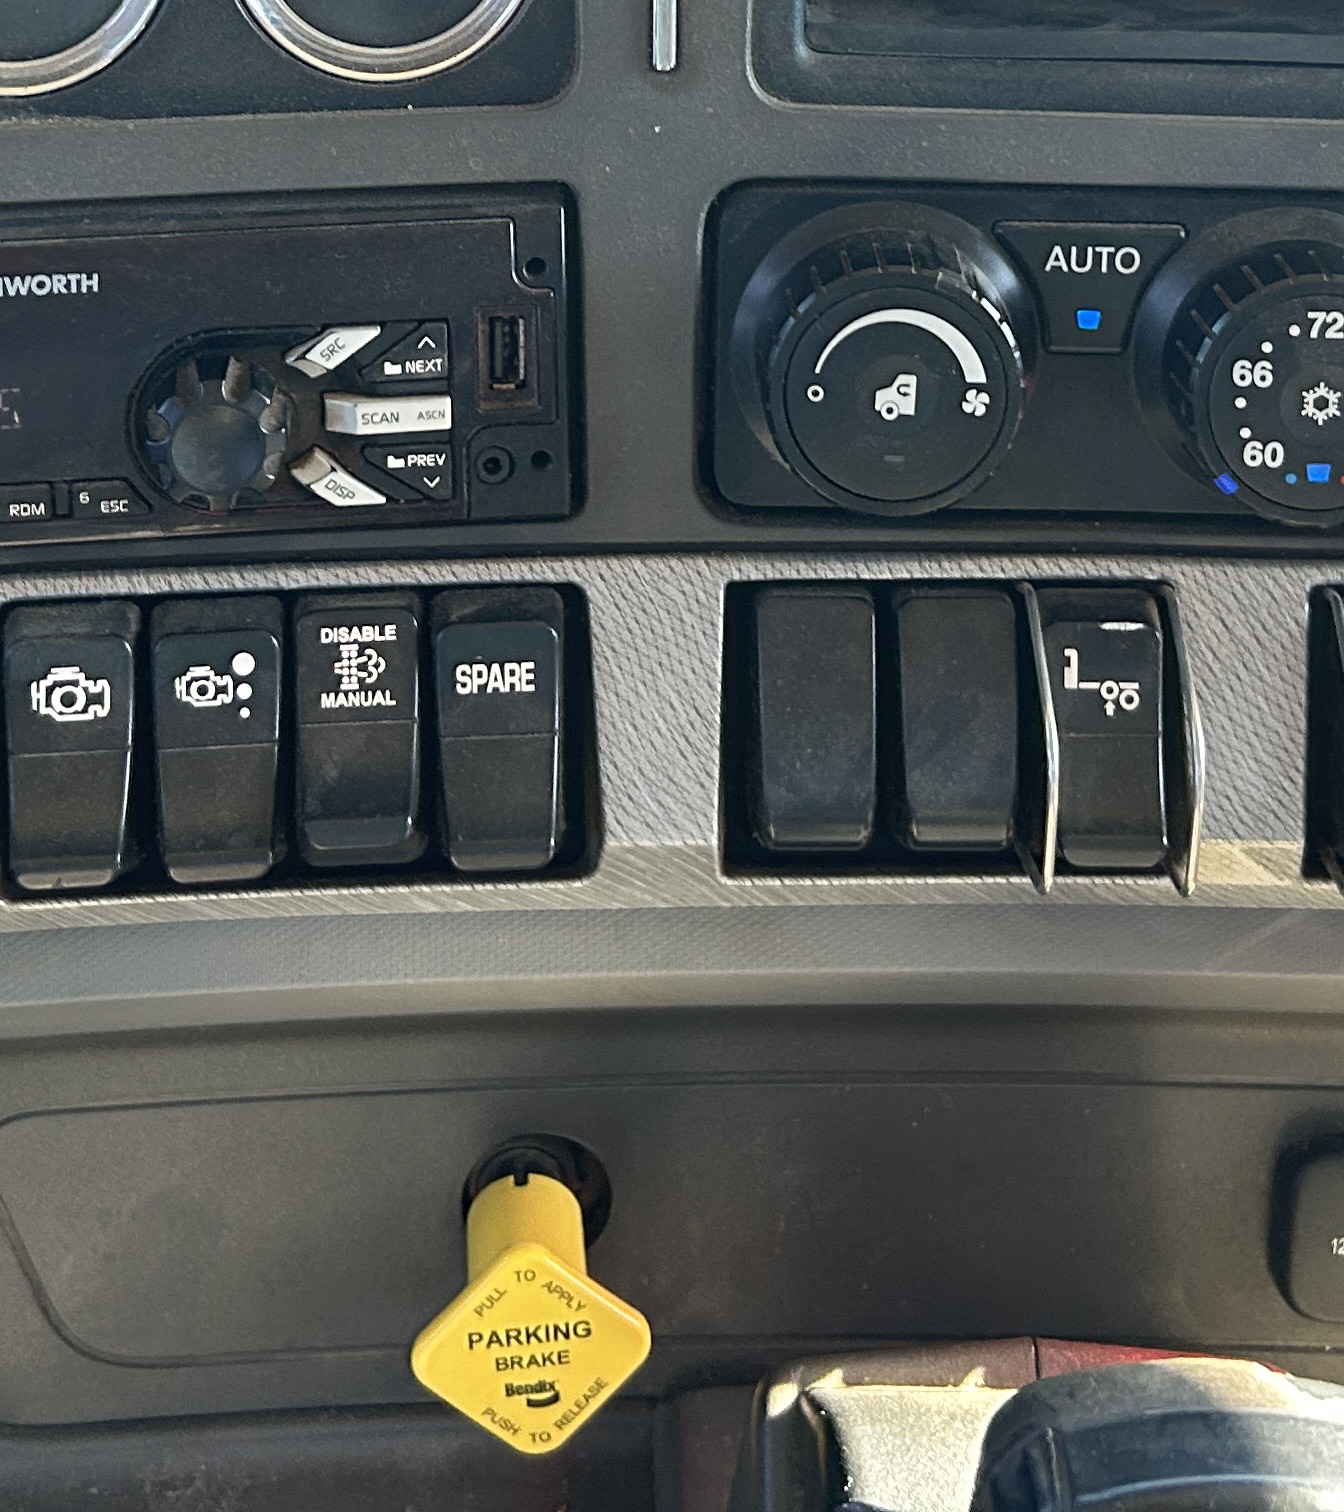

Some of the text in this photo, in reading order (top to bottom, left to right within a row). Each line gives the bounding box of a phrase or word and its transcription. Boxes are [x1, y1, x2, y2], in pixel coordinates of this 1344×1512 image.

[1045, 245, 1141, 274] AUTO
[1307, 311, 1344, 340] 72
[320, 337, 346, 362] SRC
[406, 359, 443, 373] NEXT
[1232, 360, 1273, 388] 66
[361, 409, 446, 425] SCAN ASCN
[407, 453, 446, 467] PREV
[1243, 441, 1284, 468] 60
[324, 479, 356, 500] DISP
[9, 502, 45, 517] RDM
[79, 491, 129, 513] 6 ESC
[320, 624, 397, 644] DISABLE
[455, 661, 536, 695] SPARE
[320, 690, 397, 709] MANUAL
[473, 1268, 587, 1317] PULL TO APPLY
[468, 1320, 592, 1350] PARKING
[495, 1350, 571, 1372] BRAKE
[505, 1380, 557, 1398] Bendix
[481, 1377, 609, 1445] PUSH TO RELEASE
